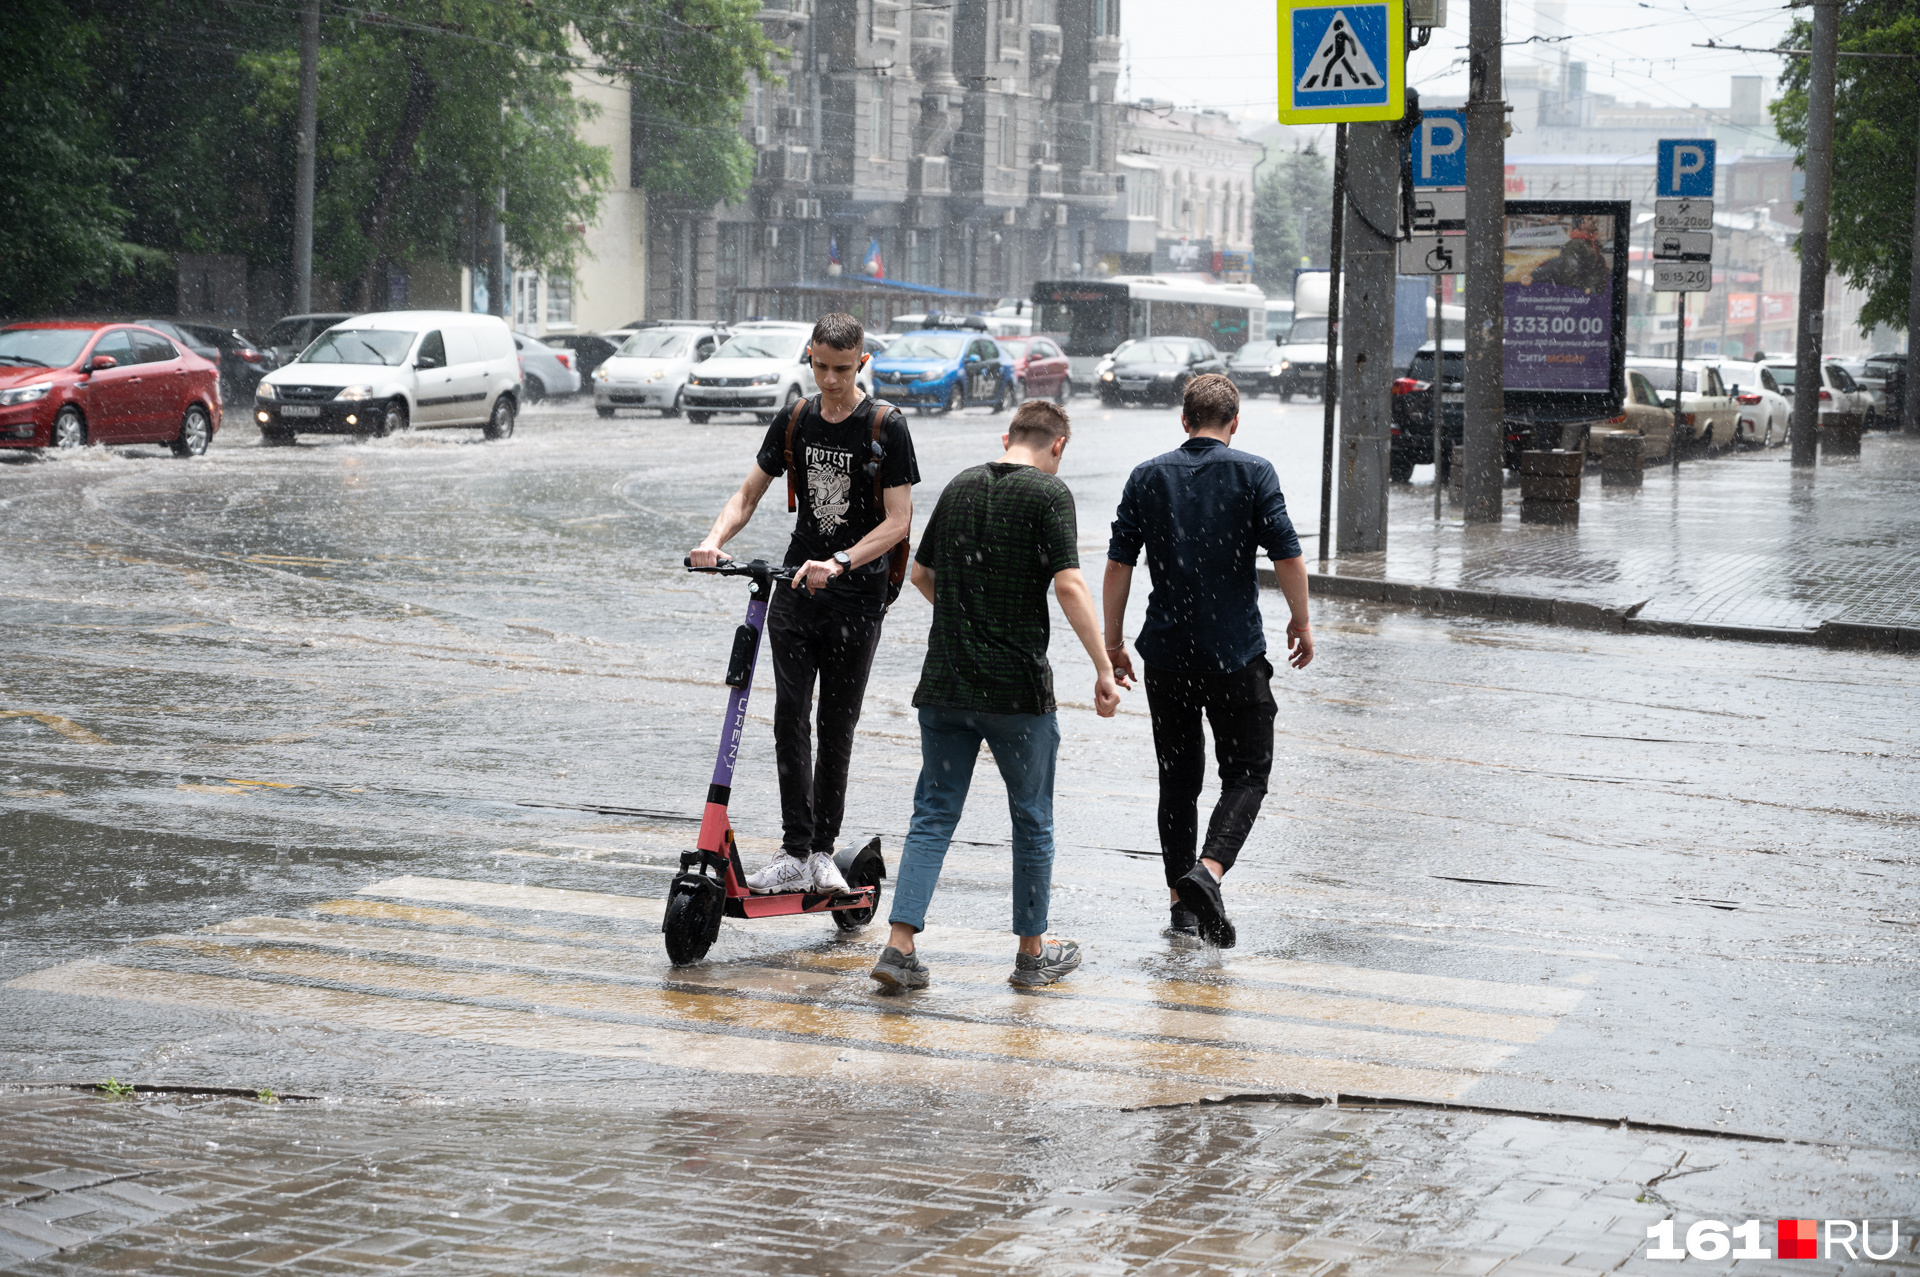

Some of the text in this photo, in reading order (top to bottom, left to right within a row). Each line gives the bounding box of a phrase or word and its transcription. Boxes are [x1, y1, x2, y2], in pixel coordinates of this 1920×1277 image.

[1421, 117, 1464, 179] P
[1672, 145, 1705, 192] P
[1687, 270, 1705, 283] 20
[938, 315, 967, 325] Uber
[1512, 317, 1549, 334] 333
[972, 376, 996, 398] Uber
[805, 446, 853, 474] PROTEST
